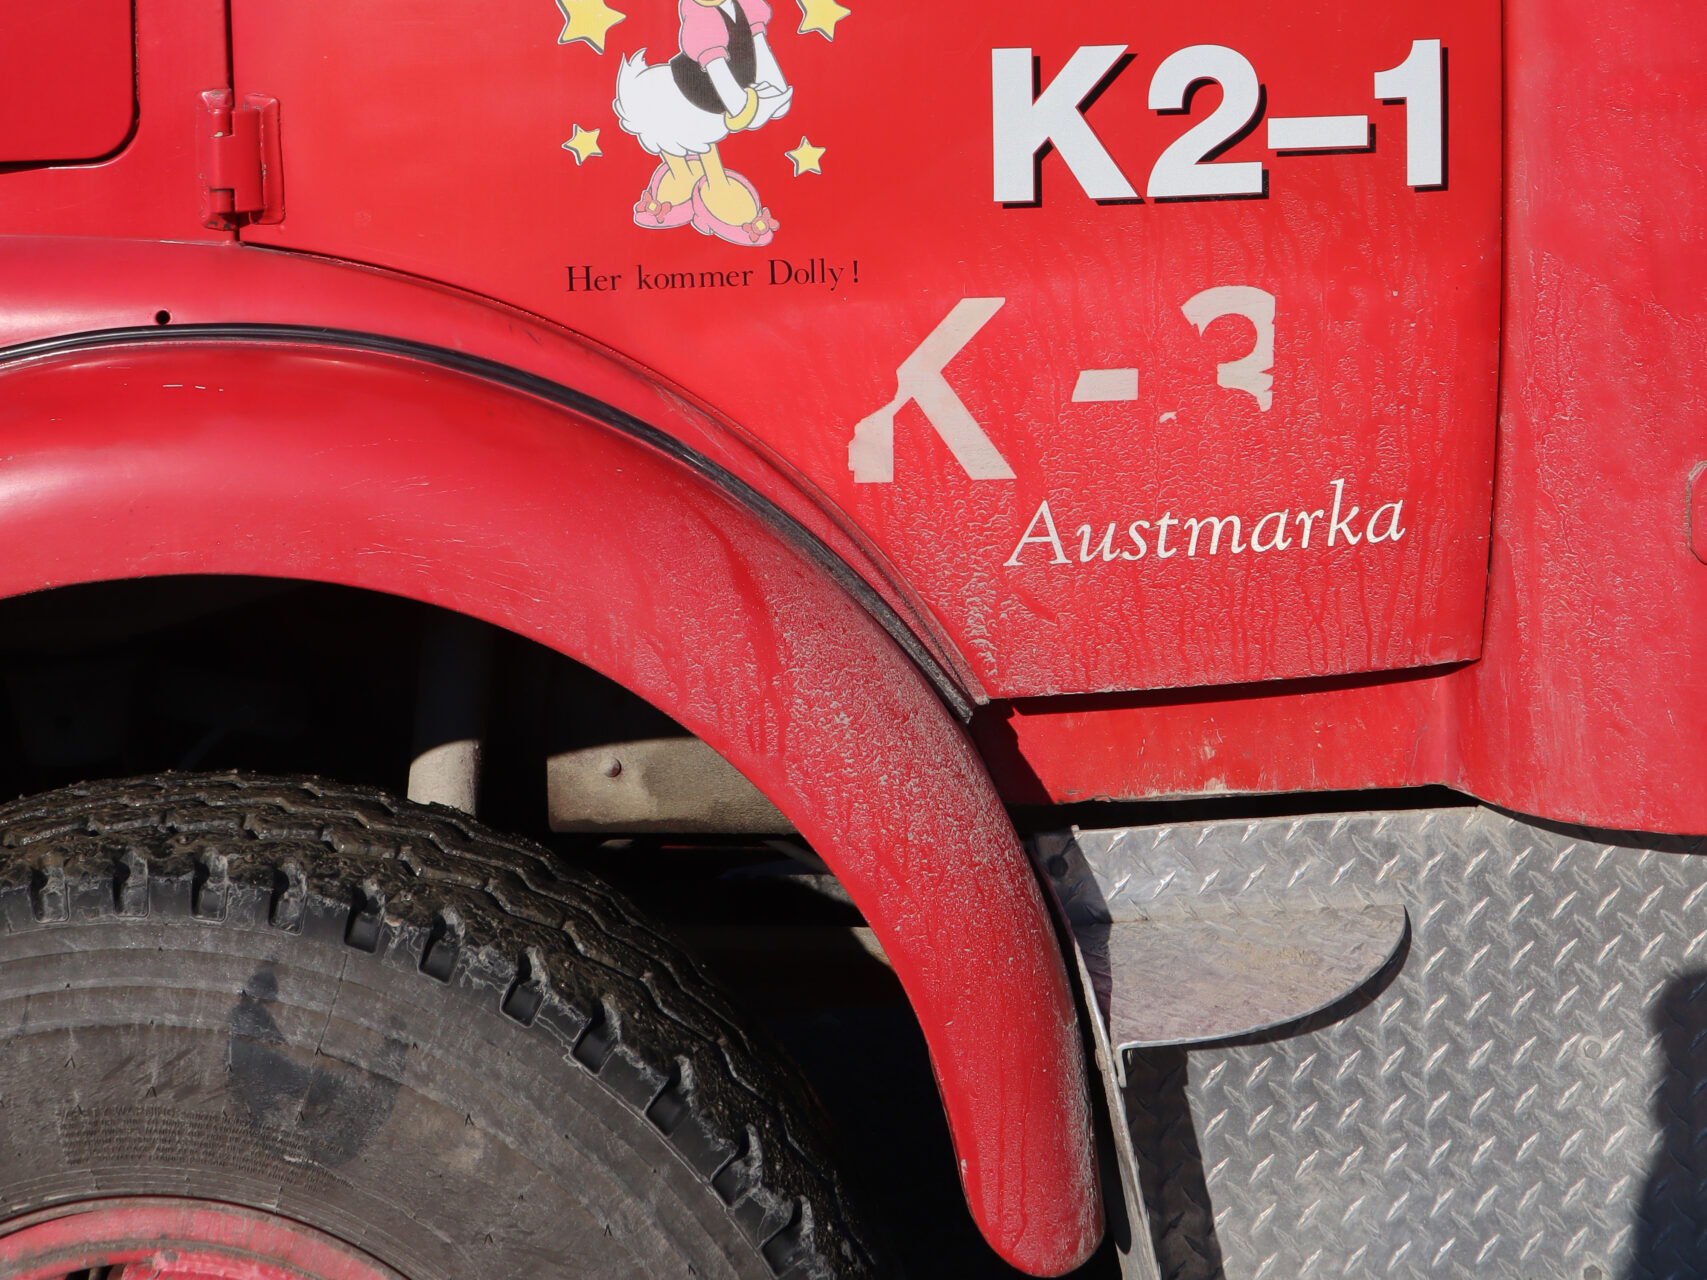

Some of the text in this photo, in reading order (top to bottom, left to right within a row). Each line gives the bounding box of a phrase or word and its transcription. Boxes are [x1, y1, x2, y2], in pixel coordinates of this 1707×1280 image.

[991, 38, 1449, 209] K2-1
[567, 265, 622, 292] Her
[637, 264, 754, 290] kommer
[1003, 478, 1406, 567] Austmarka
